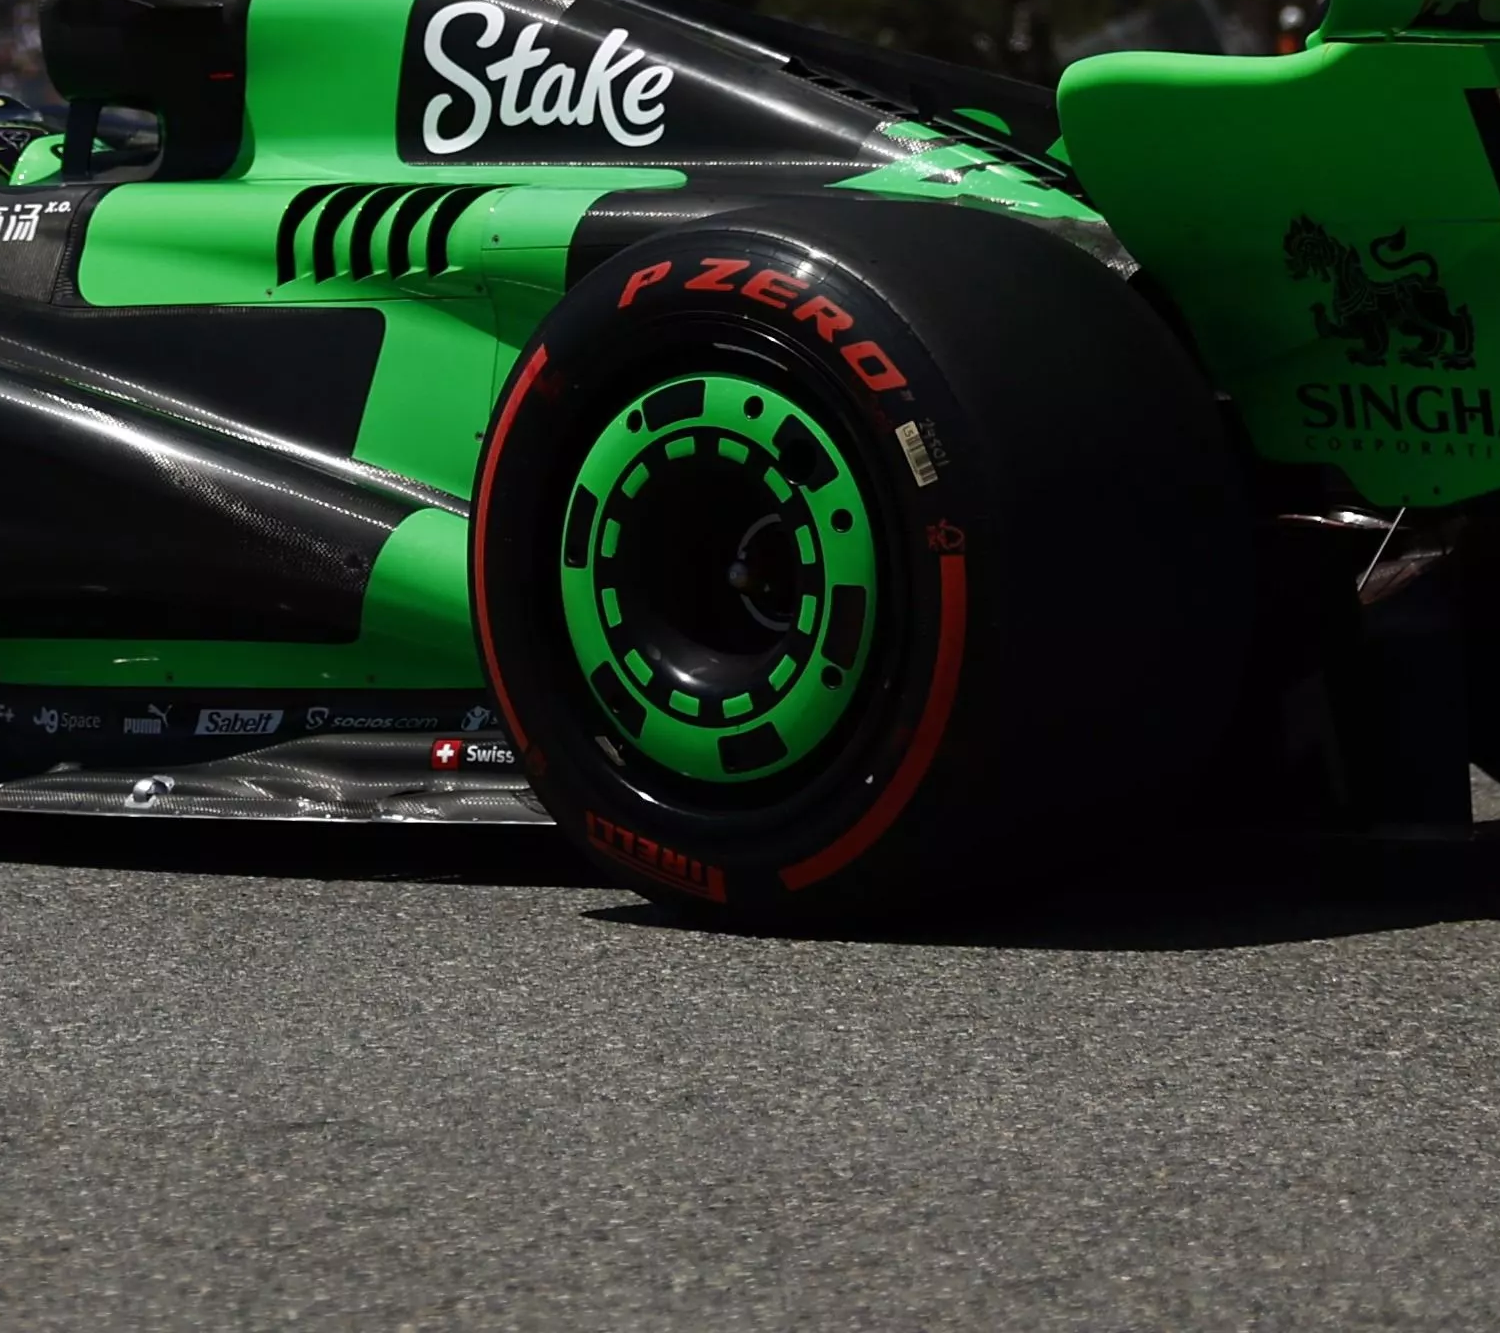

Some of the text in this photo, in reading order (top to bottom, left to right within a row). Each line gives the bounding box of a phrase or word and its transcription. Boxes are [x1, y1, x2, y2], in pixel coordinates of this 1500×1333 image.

[421, 0, 673, 155] Stake
[617, 257, 908, 392] P ZERO
[205, 711, 274, 734] Sabelt
[465, 744, 516, 765] Swiss
